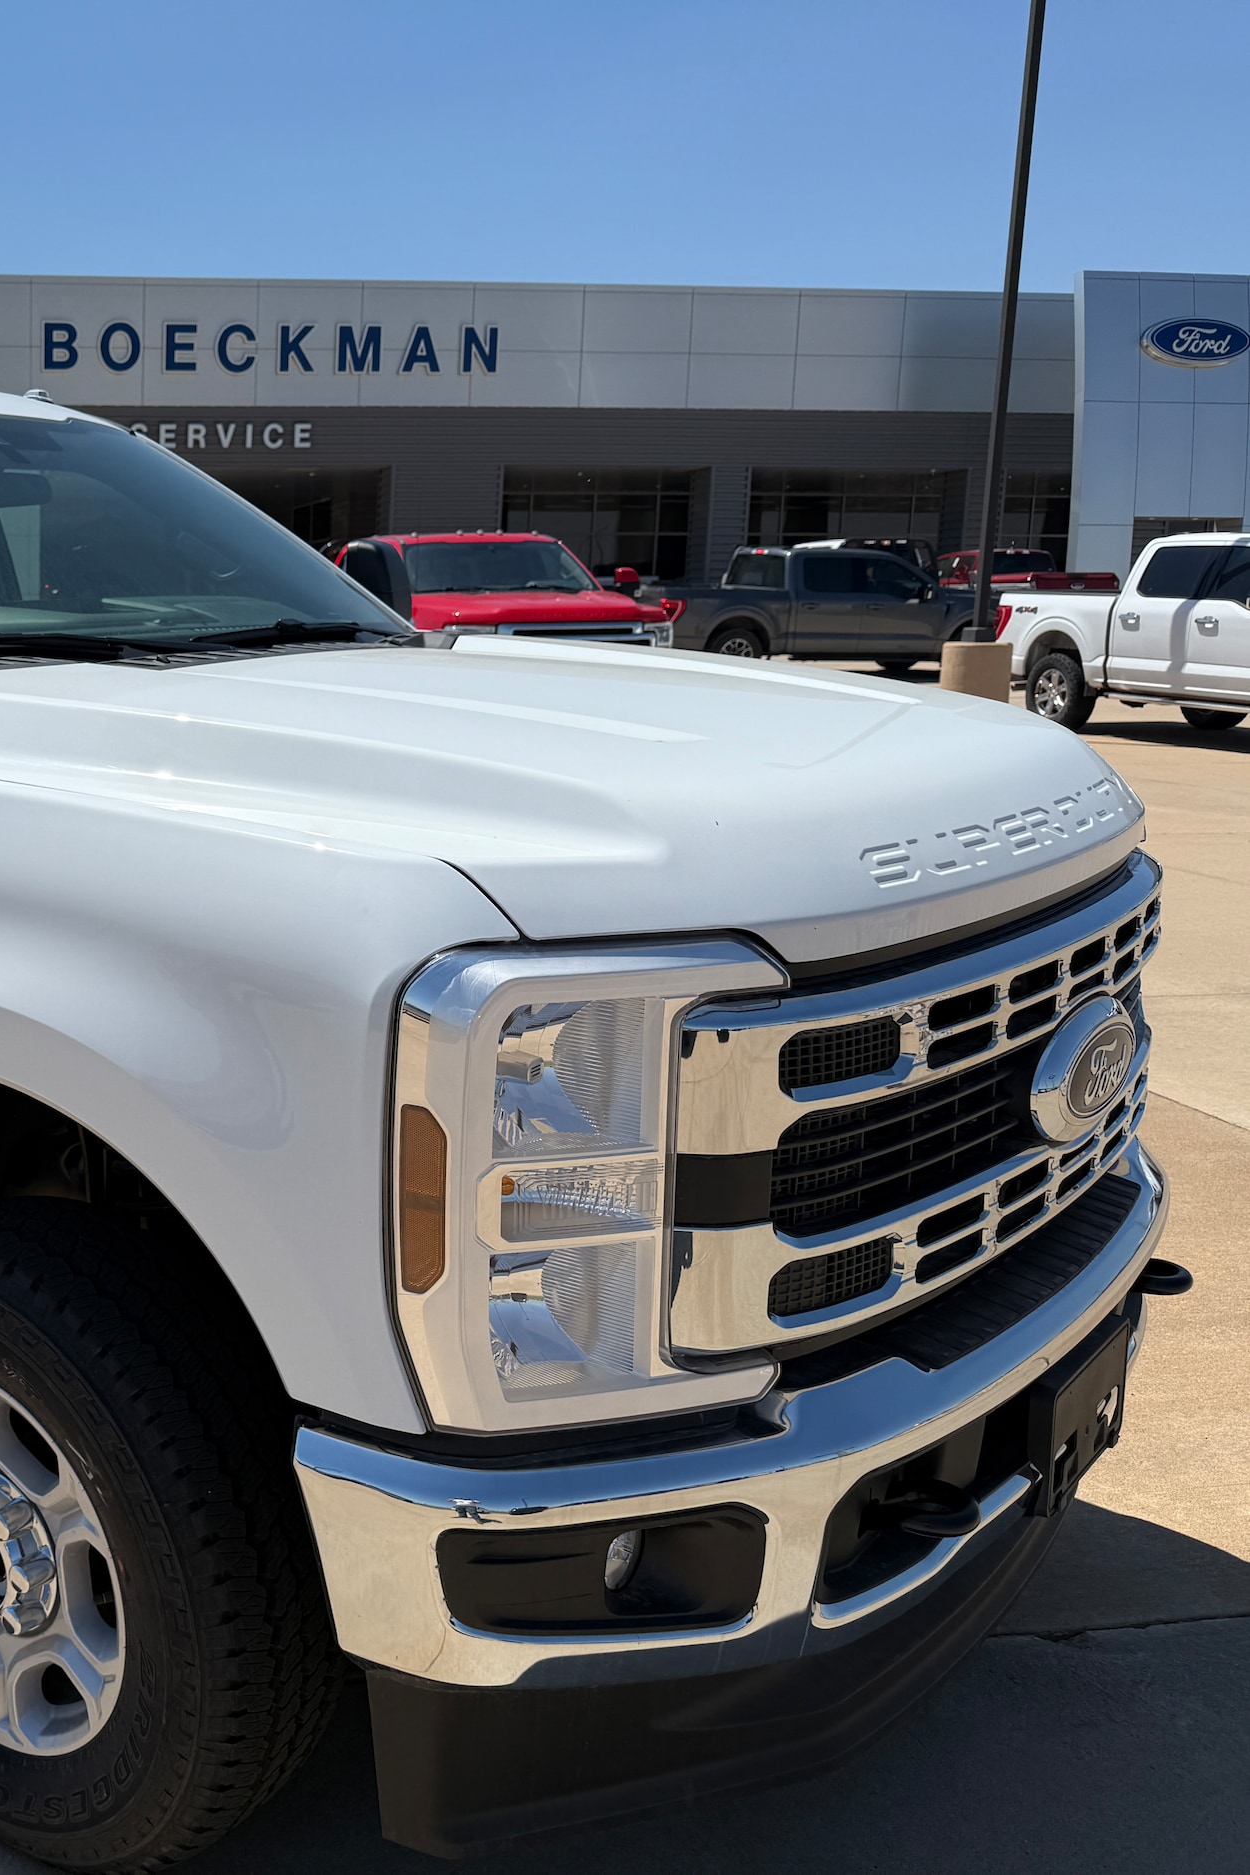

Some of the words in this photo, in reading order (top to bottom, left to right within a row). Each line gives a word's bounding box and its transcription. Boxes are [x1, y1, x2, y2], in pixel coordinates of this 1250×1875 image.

[43, 321, 500, 374] BOECKMAN
[1172, 326, 1232, 354] Ford
[859, 806, 1069, 889] SUPER
[1084, 1038, 1127, 1106] Ford
